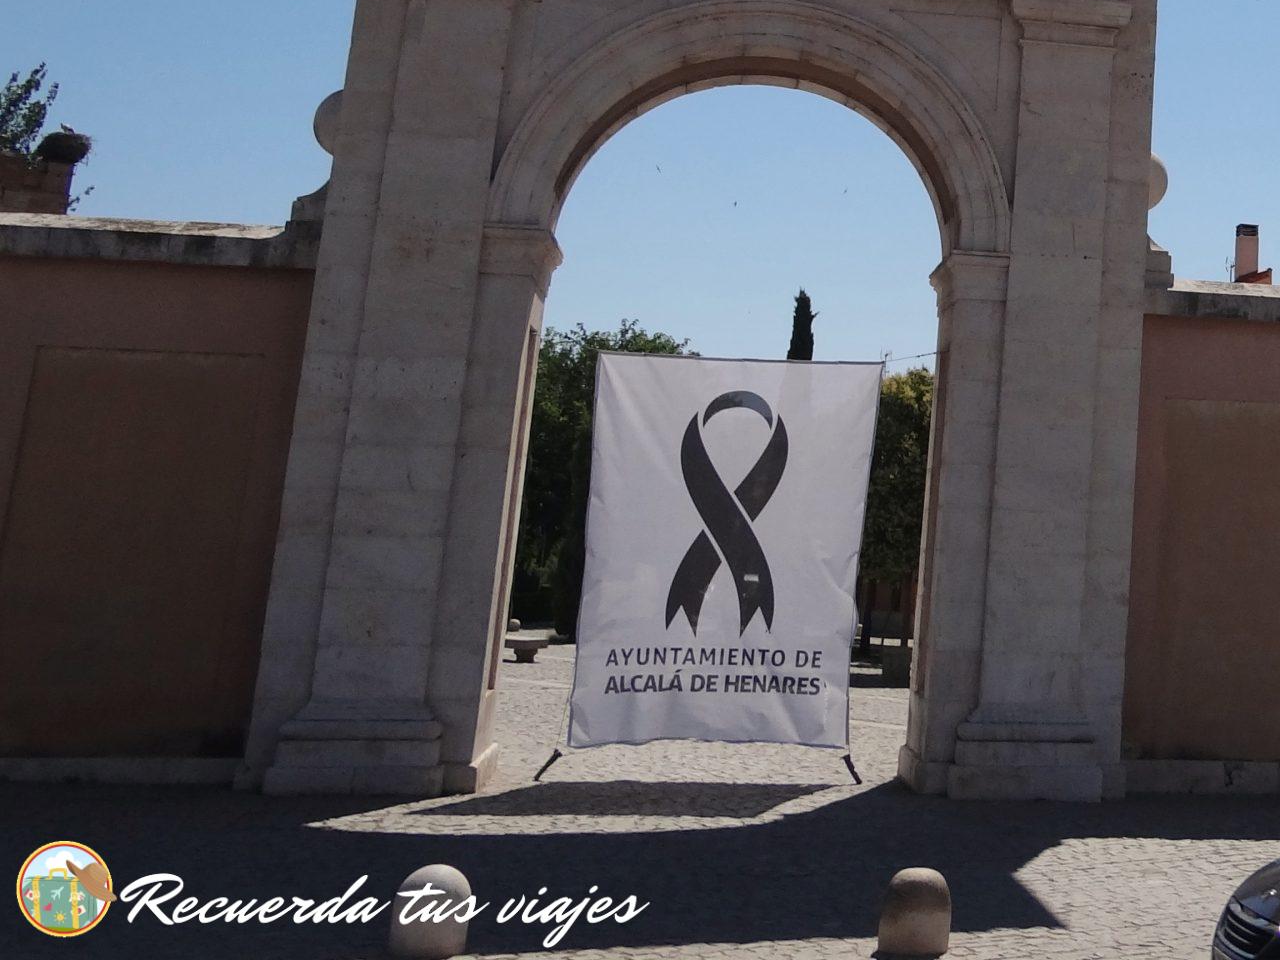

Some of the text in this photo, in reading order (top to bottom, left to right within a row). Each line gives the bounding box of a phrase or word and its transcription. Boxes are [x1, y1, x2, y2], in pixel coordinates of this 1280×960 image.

[605, 647, 823, 668] AYUNTAMIENTO DE
[604, 669, 820, 695] ALCALÁ DE HENARES
